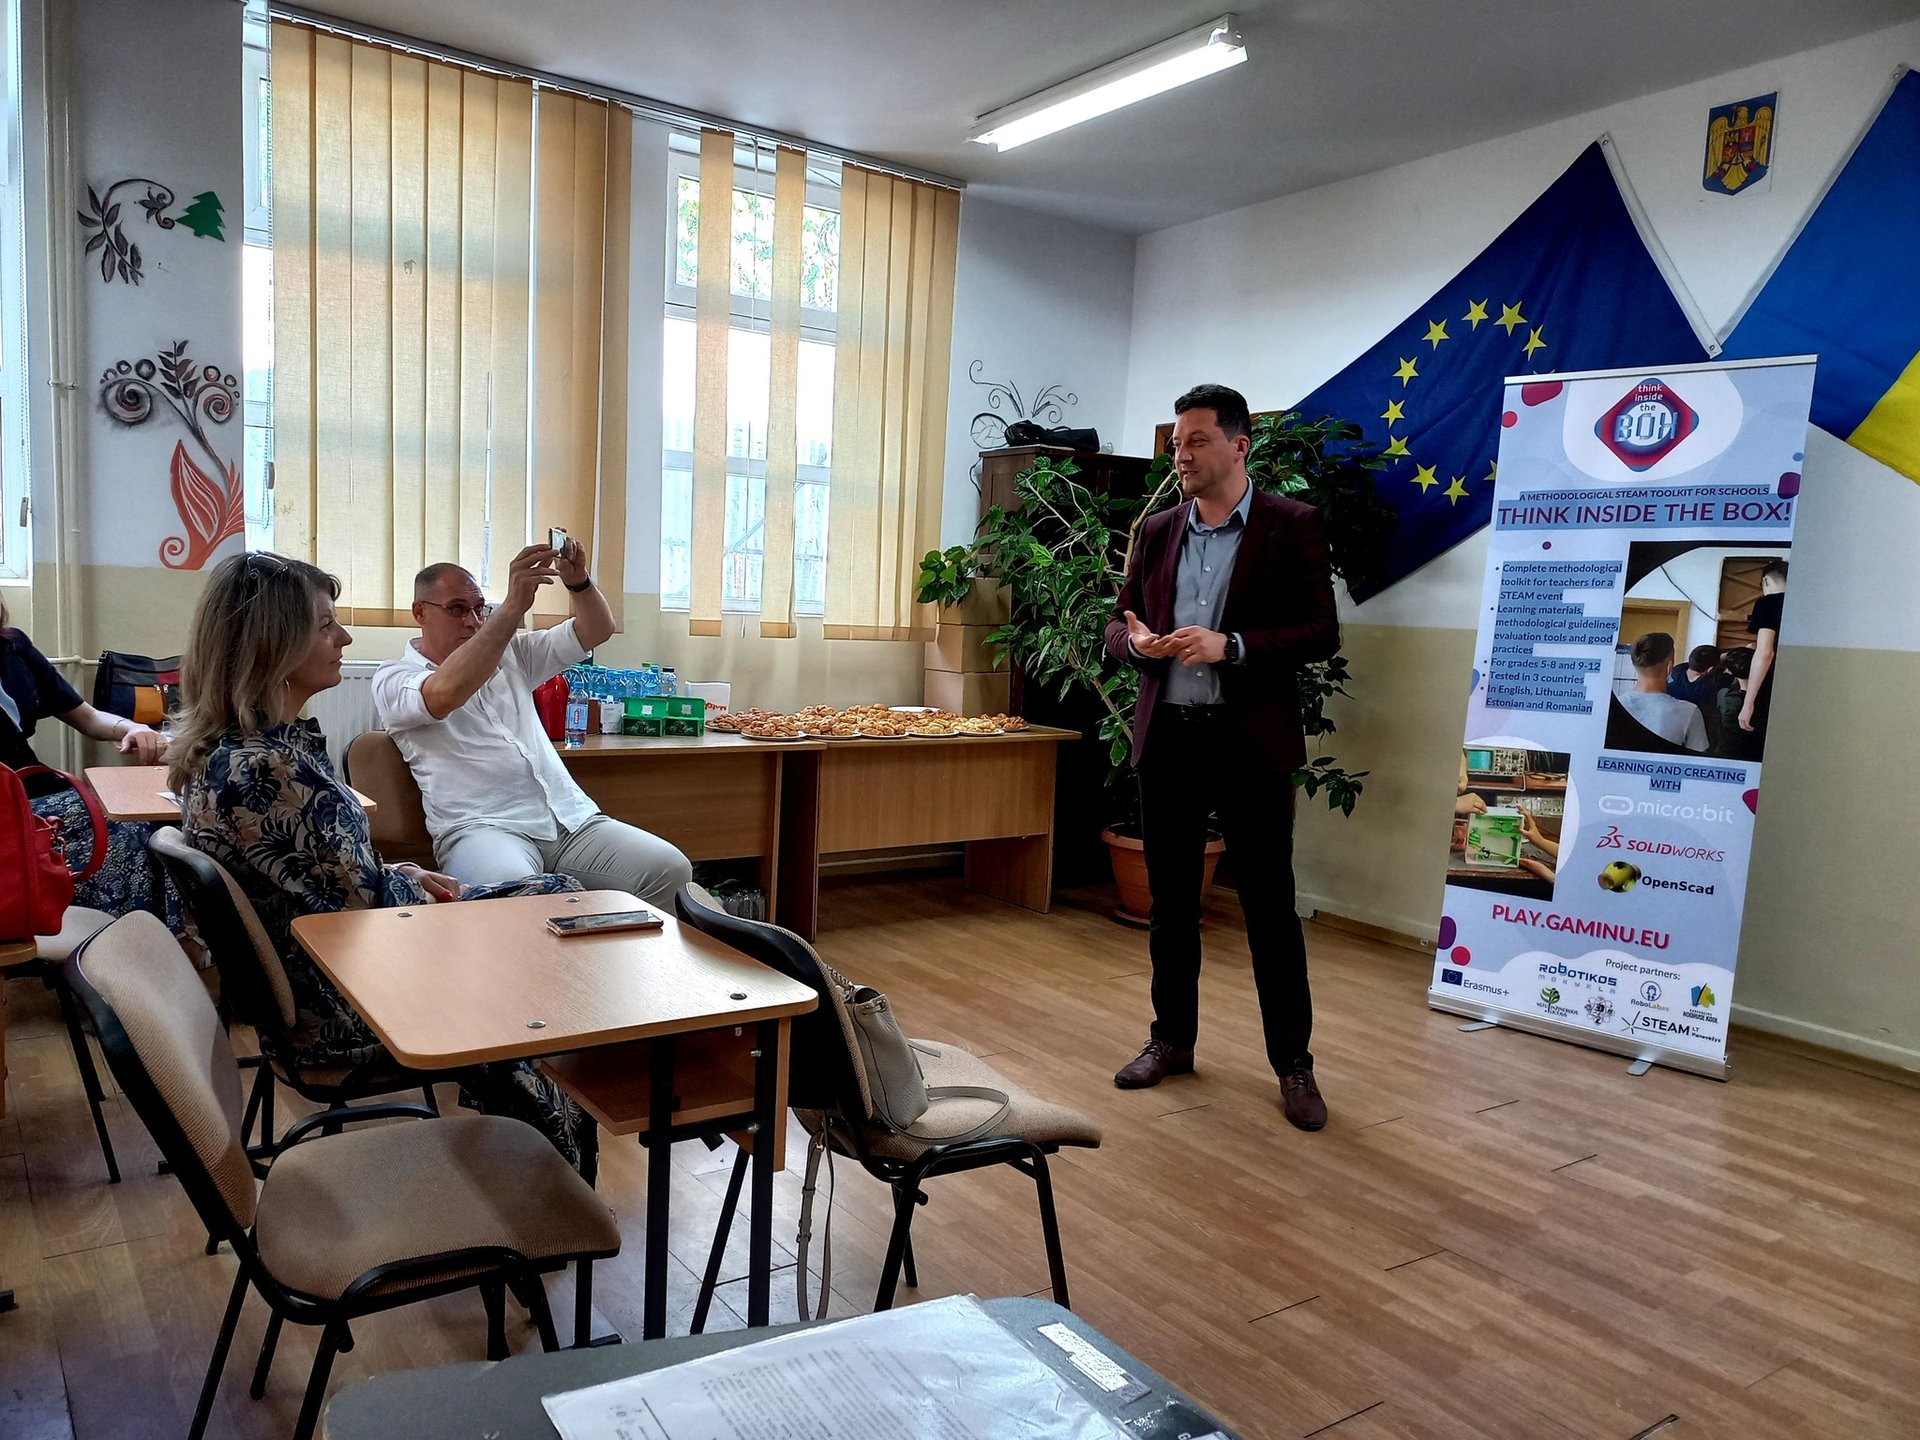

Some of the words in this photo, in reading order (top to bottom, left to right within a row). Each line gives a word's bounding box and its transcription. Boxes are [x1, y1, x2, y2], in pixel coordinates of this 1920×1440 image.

[1638, 384, 1662, 393] think
[1635, 392, 1663, 402] inside
[1640, 403, 1656, 412] the
[1519, 493, 1526, 501] A
[1528, 490, 1613, 501] METHODOLOGICAL
[1615, 490, 1649, 499] STEAM
[1651, 489, 1694, 498] TOOLKIT
[1695, 488, 1717, 496] FOR
[1718, 487, 1769, 496] SCHOOLS
[1499, 505, 1570, 525] THINK
[1576, 504, 1657, 524] INSIDE
[1665, 503, 1714, 522] THE
[1723, 502, 1791, 521] BOX!
[1503, 564, 1547, 575] Complete
[1549, 564, 1622, 575] methodological
[1501, 577, 1531, 586] toolkit
[1533, 578, 1547, 586] for
[1549, 578, 1589, 587] teachers
[1591, 578, 1605, 587] for
[1497, 605, 1536, 615] Learning
[1538, 606, 1583, 616] materials,
[1496, 619, 1566, 630] methodological
[1568, 620, 1618, 631] guidelines,
[1494, 632, 1541, 641] evaluation
[1544, 633, 1566, 642] tools
[1569, 634, 1586, 643] and
[1588, 635, 1613, 644] good
[1492, 645, 1533, 655] practices
[1491, 658, 1506, 666] For
[1508, 659, 1538, 669] grades
[1540, 660, 1556, 669] 5-8
[1559, 661, 1575, 669] and
[1579, 662, 1600, 670] 9-12
[1490, 671, 1520, 680] Tested
[1522, 672, 1530, 681] in
[1533, 673, 1539, 681] 3
[1541, 674, 1584, 684] countries
[1488, 685, 1496, 693] In
[1499, 685, 1533, 696] English,
[1486, 698, 1524, 708] Estonian
[1527, 701, 1543, 709] and
[1546, 702, 1592, 713] Romanian
[1597, 759, 1654, 773] LEARNING
[1656, 765, 1682, 776] AND
[1684, 768, 1746, 782] CREATING
[1650, 779, 1681, 791] WITH
[1636, 800, 1734, 824] micro:bit
[1627, 840, 1726, 862] SOLIDWORKS
[1642, 875, 1715, 895] OpenScad
[1492, 904, 1670, 949] PLAY.GAMINU.EU
[1606, 958, 1637, 973] Project
[1640, 965, 1680, 980] partners:
[1463, 980, 1510, 996] Erasmus+
[1642, 1016, 1690, 1036] STEAM
